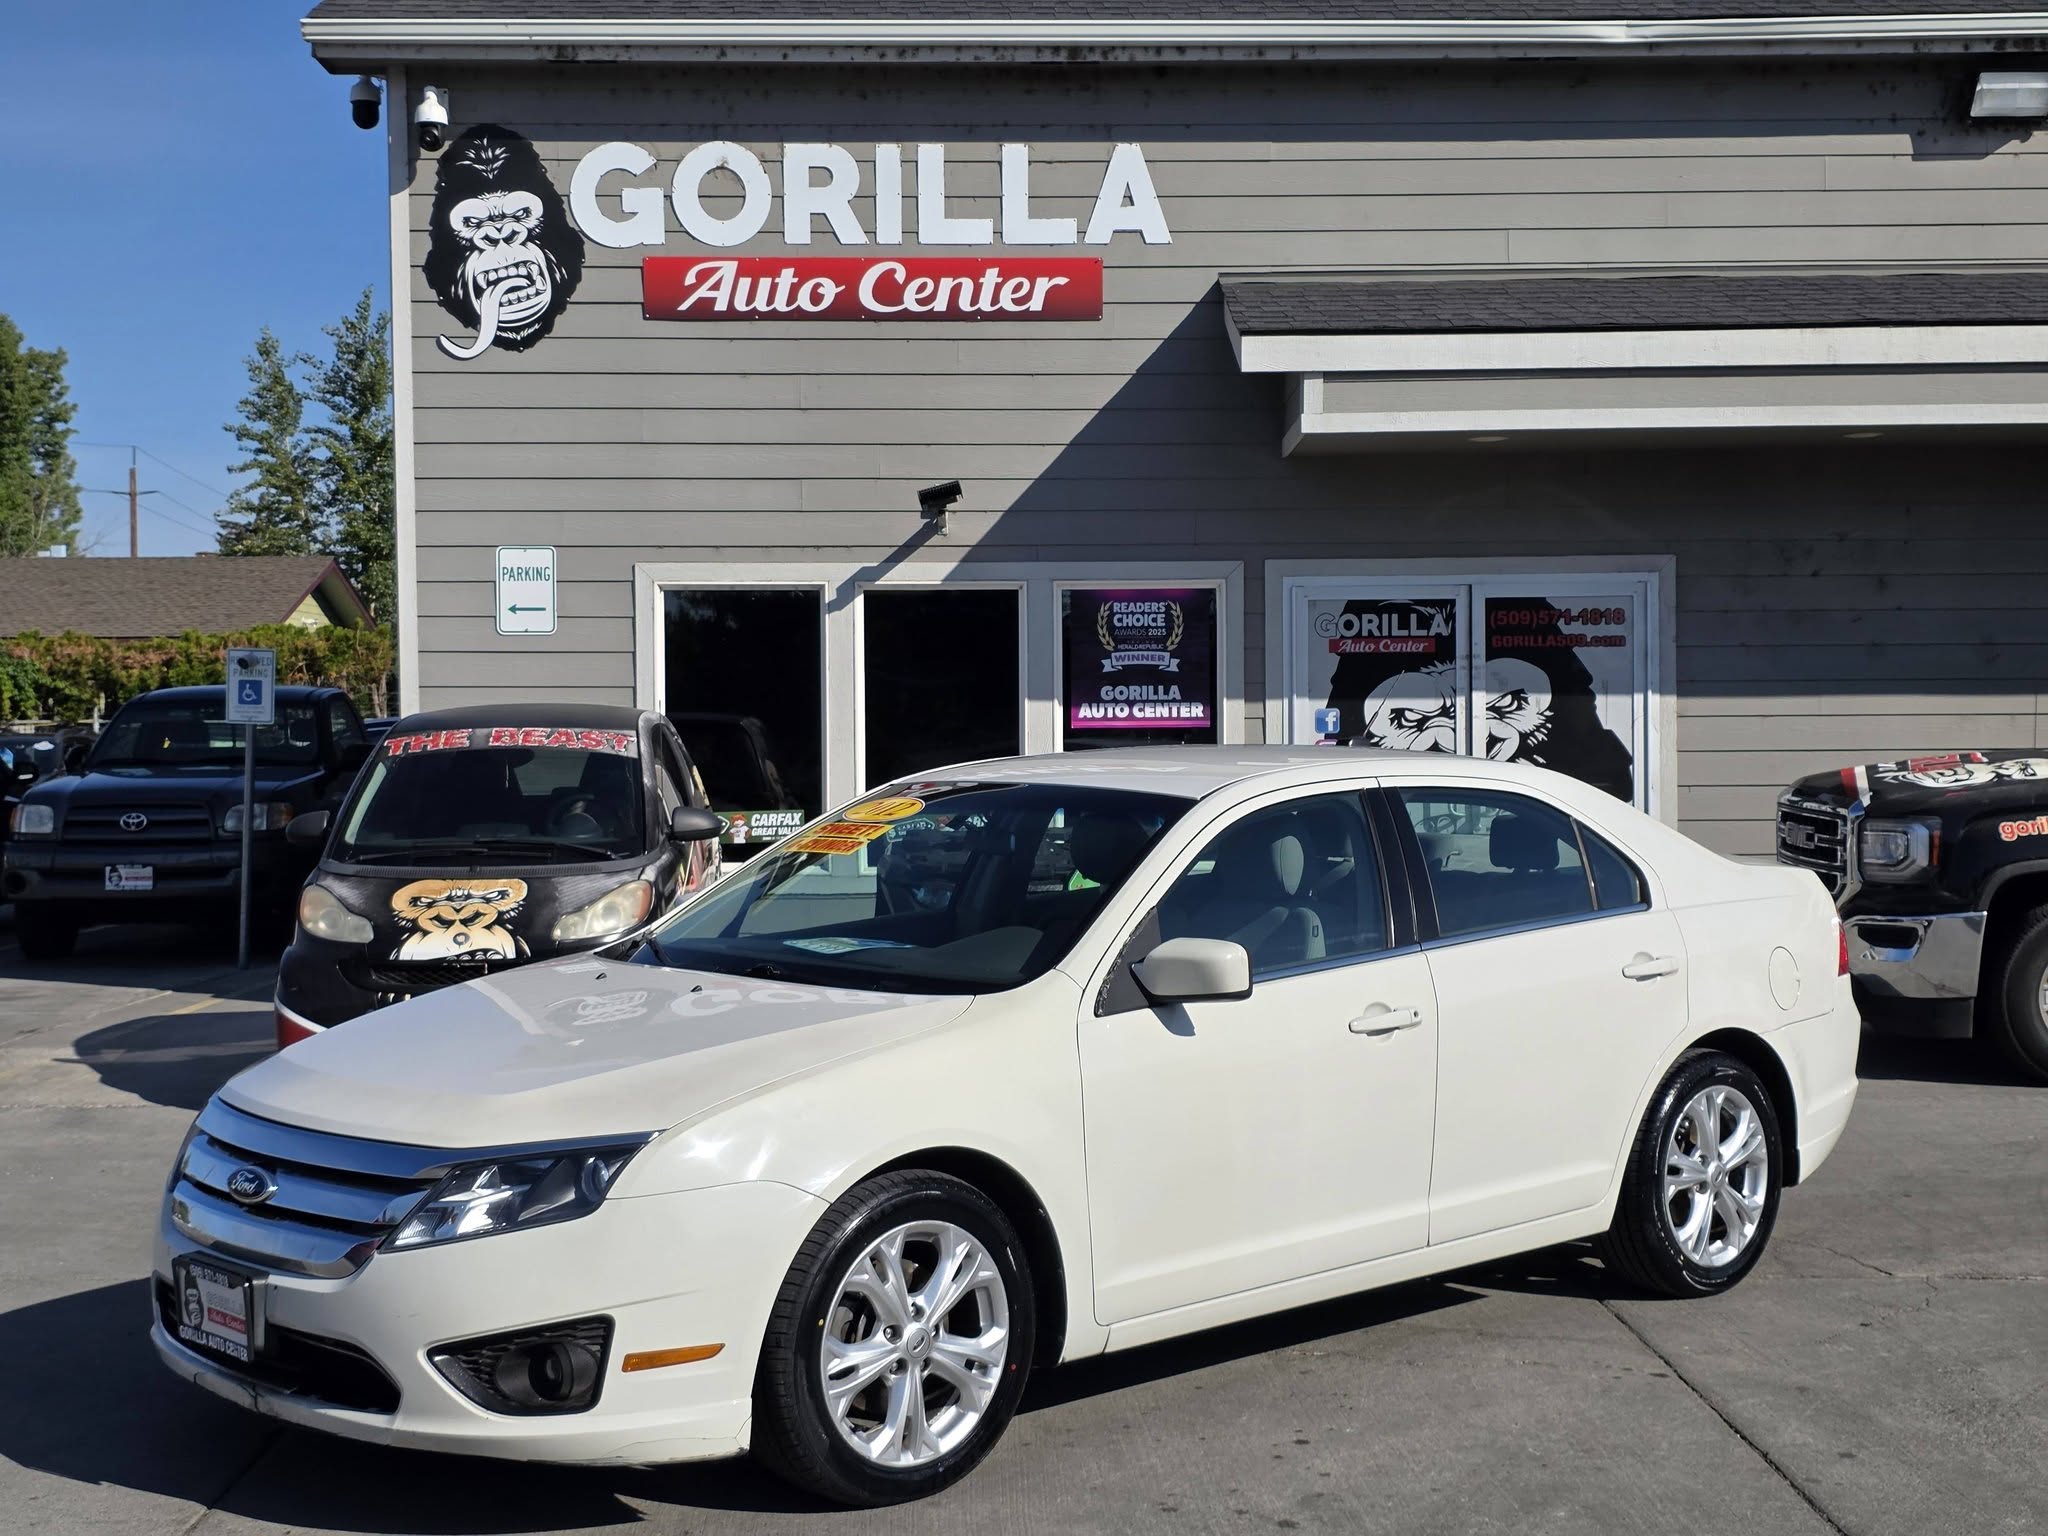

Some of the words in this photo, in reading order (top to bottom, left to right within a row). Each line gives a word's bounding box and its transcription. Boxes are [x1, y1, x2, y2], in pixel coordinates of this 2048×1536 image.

[570, 141, 1172, 248] GORILLA
[677, 261, 845, 312] Auto
[859, 261, 1070, 312] Center
[502, 566, 551, 582] PARKING
[1113, 602, 1168, 613] READERS'
[1113, 614, 1166, 627] CHOICE
[1314, 612, 1449, 638] GORILLA
[1148, 628, 1167, 636] 2025
[1338, 639, 1376, 653] Auto
[1379, 639, 1429, 653] Center
[1491, 633, 1626, 648] GORILLA509.com
[1114, 653, 1166, 662] WINNER
[1100, 685, 1182, 701] GORILLA
[1078, 703, 1130, 718] AUTO
[1132, 702, 1204, 718] CENTER
[384, 729, 473, 757] THE
[488, 727, 637, 752] BEAST
[751, 813, 802, 827] CARFAX
[751, 827, 777, 836] GREAT
[1998, 815, 2048, 842] gori
[231, 1170, 259, 1194] Ford
[180, 1324, 207, 1345] GORILLA
[208, 1334, 225, 1352] AUTO
[226, 1340, 249, 1362] CENTER
